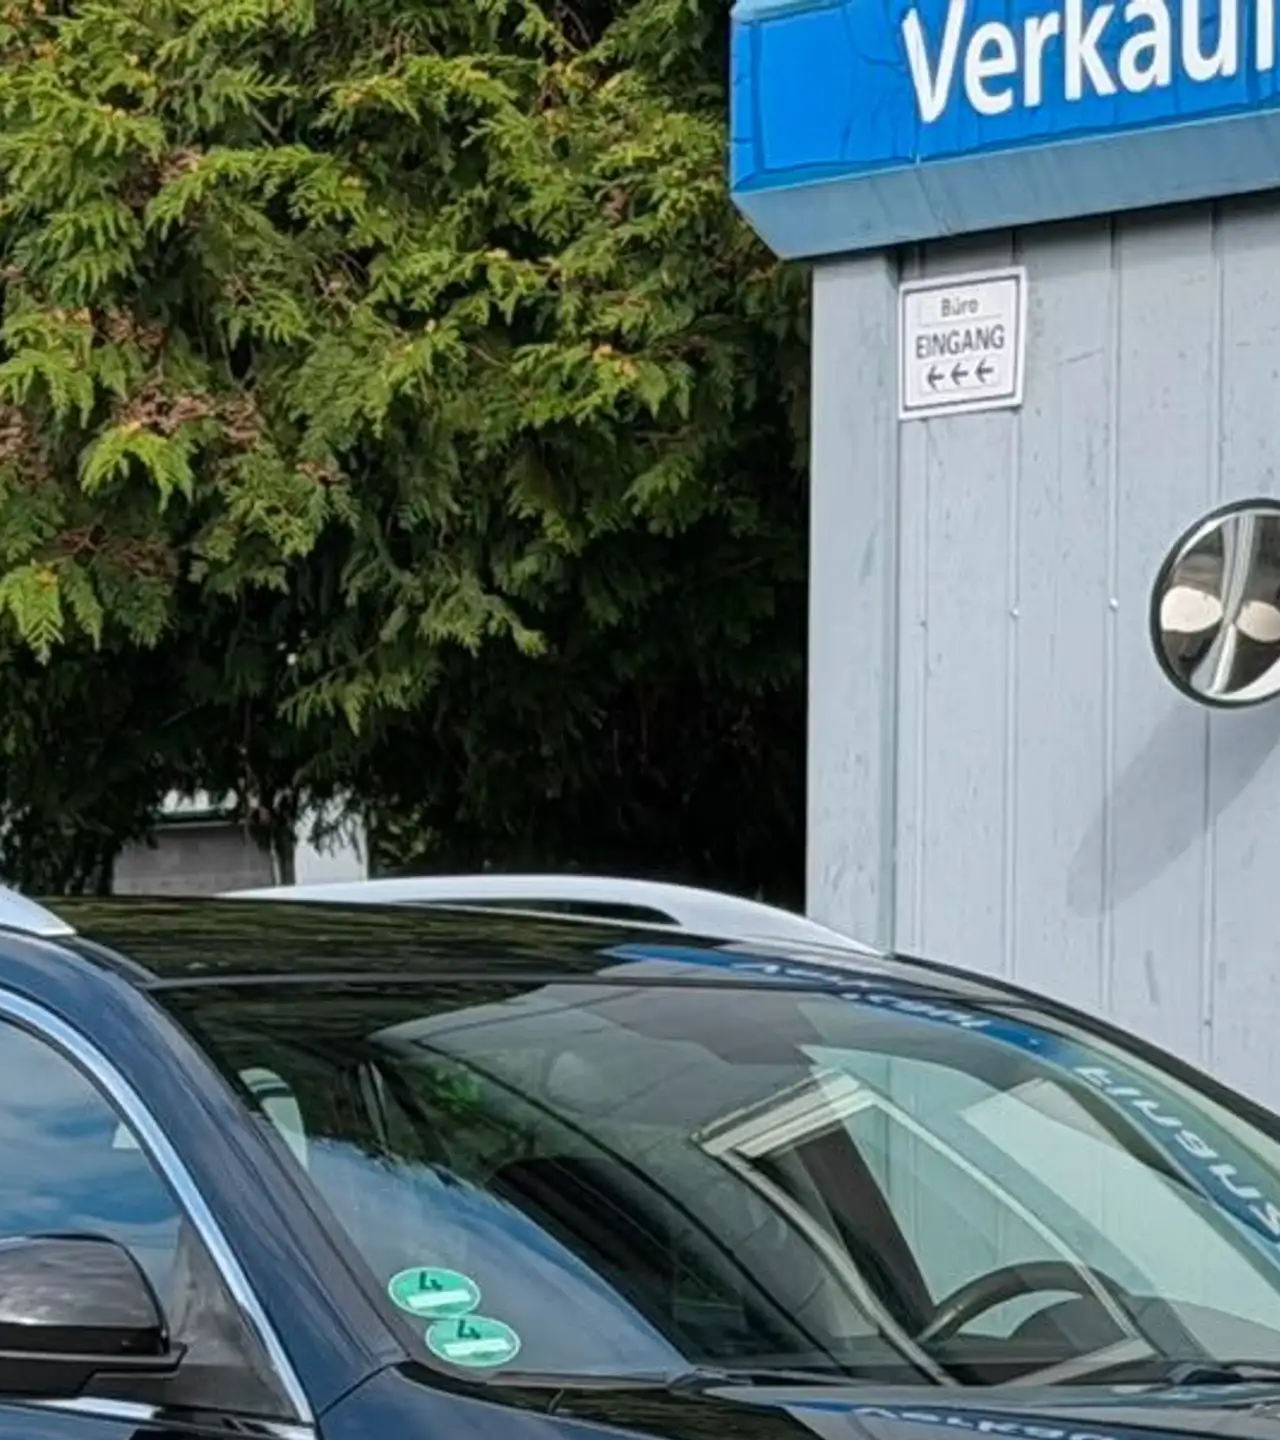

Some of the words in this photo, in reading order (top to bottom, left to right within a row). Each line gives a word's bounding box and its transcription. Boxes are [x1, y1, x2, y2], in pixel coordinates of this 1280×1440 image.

[940, 295, 980, 318] Büro
[915, 323, 1006, 360] EINGANG
[418, 1271, 444, 1291] 4
[457, 1319, 482, 1340] 4
